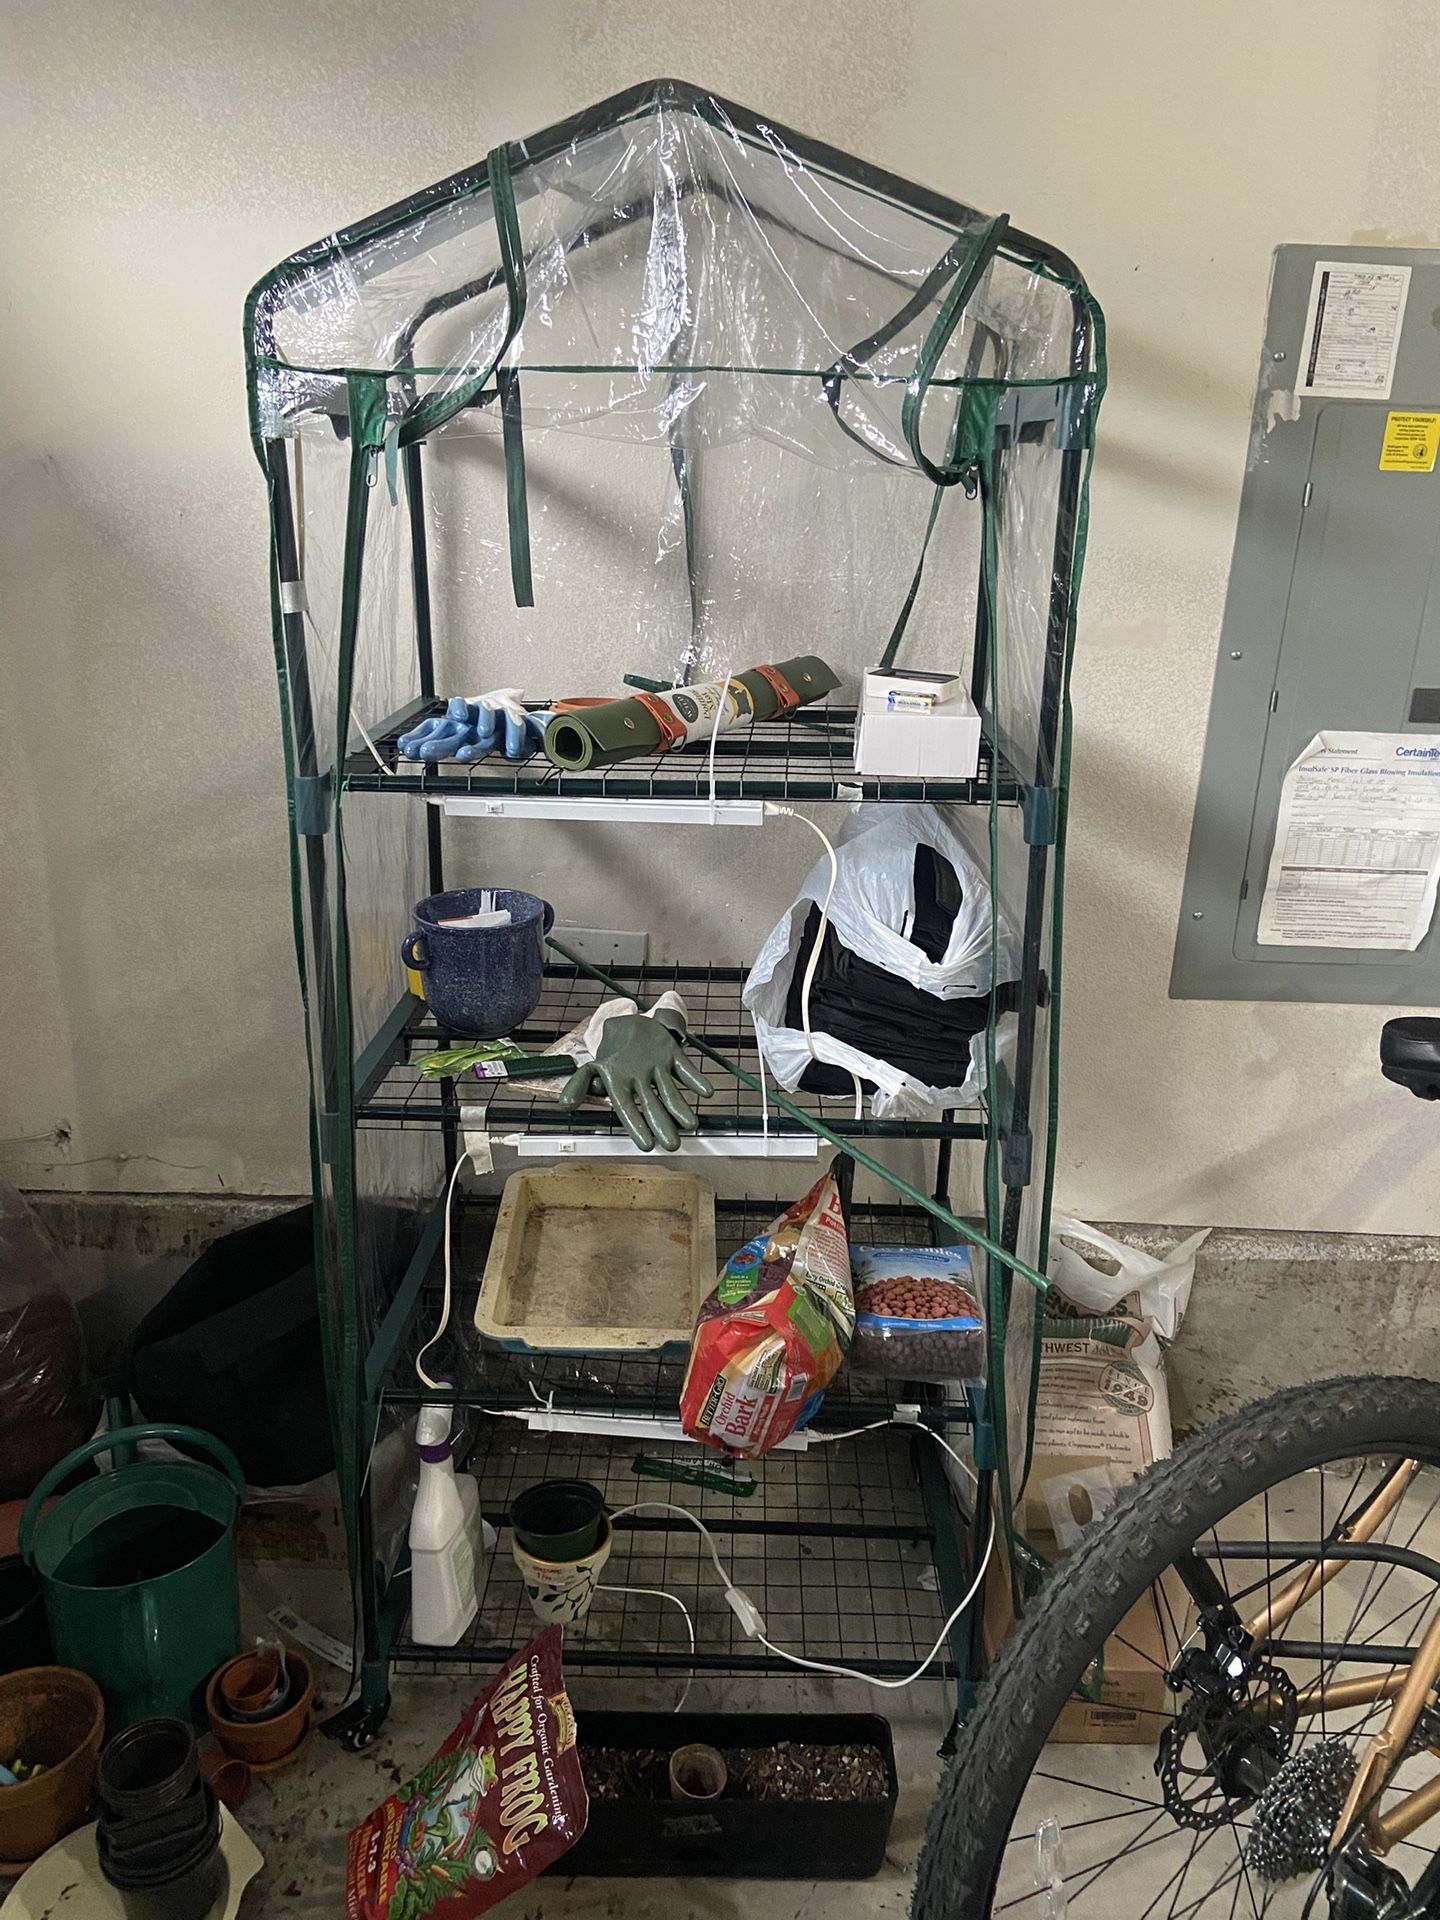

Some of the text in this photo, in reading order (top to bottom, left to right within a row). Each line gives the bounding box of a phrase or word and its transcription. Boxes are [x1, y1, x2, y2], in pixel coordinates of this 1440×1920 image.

[1341, 767, 1359, 775] Fiber
[1380, 769, 1406, 777] Blowing
[819, 1275, 836, 1287] Orchid
[715, 1391, 736, 1426] Orchid
[725, 1395, 758, 1438] Bark
[489, 1662, 549, 1855] HAPPY FROG
[529, 1654, 566, 1826] Crafted for Organic Gardening
